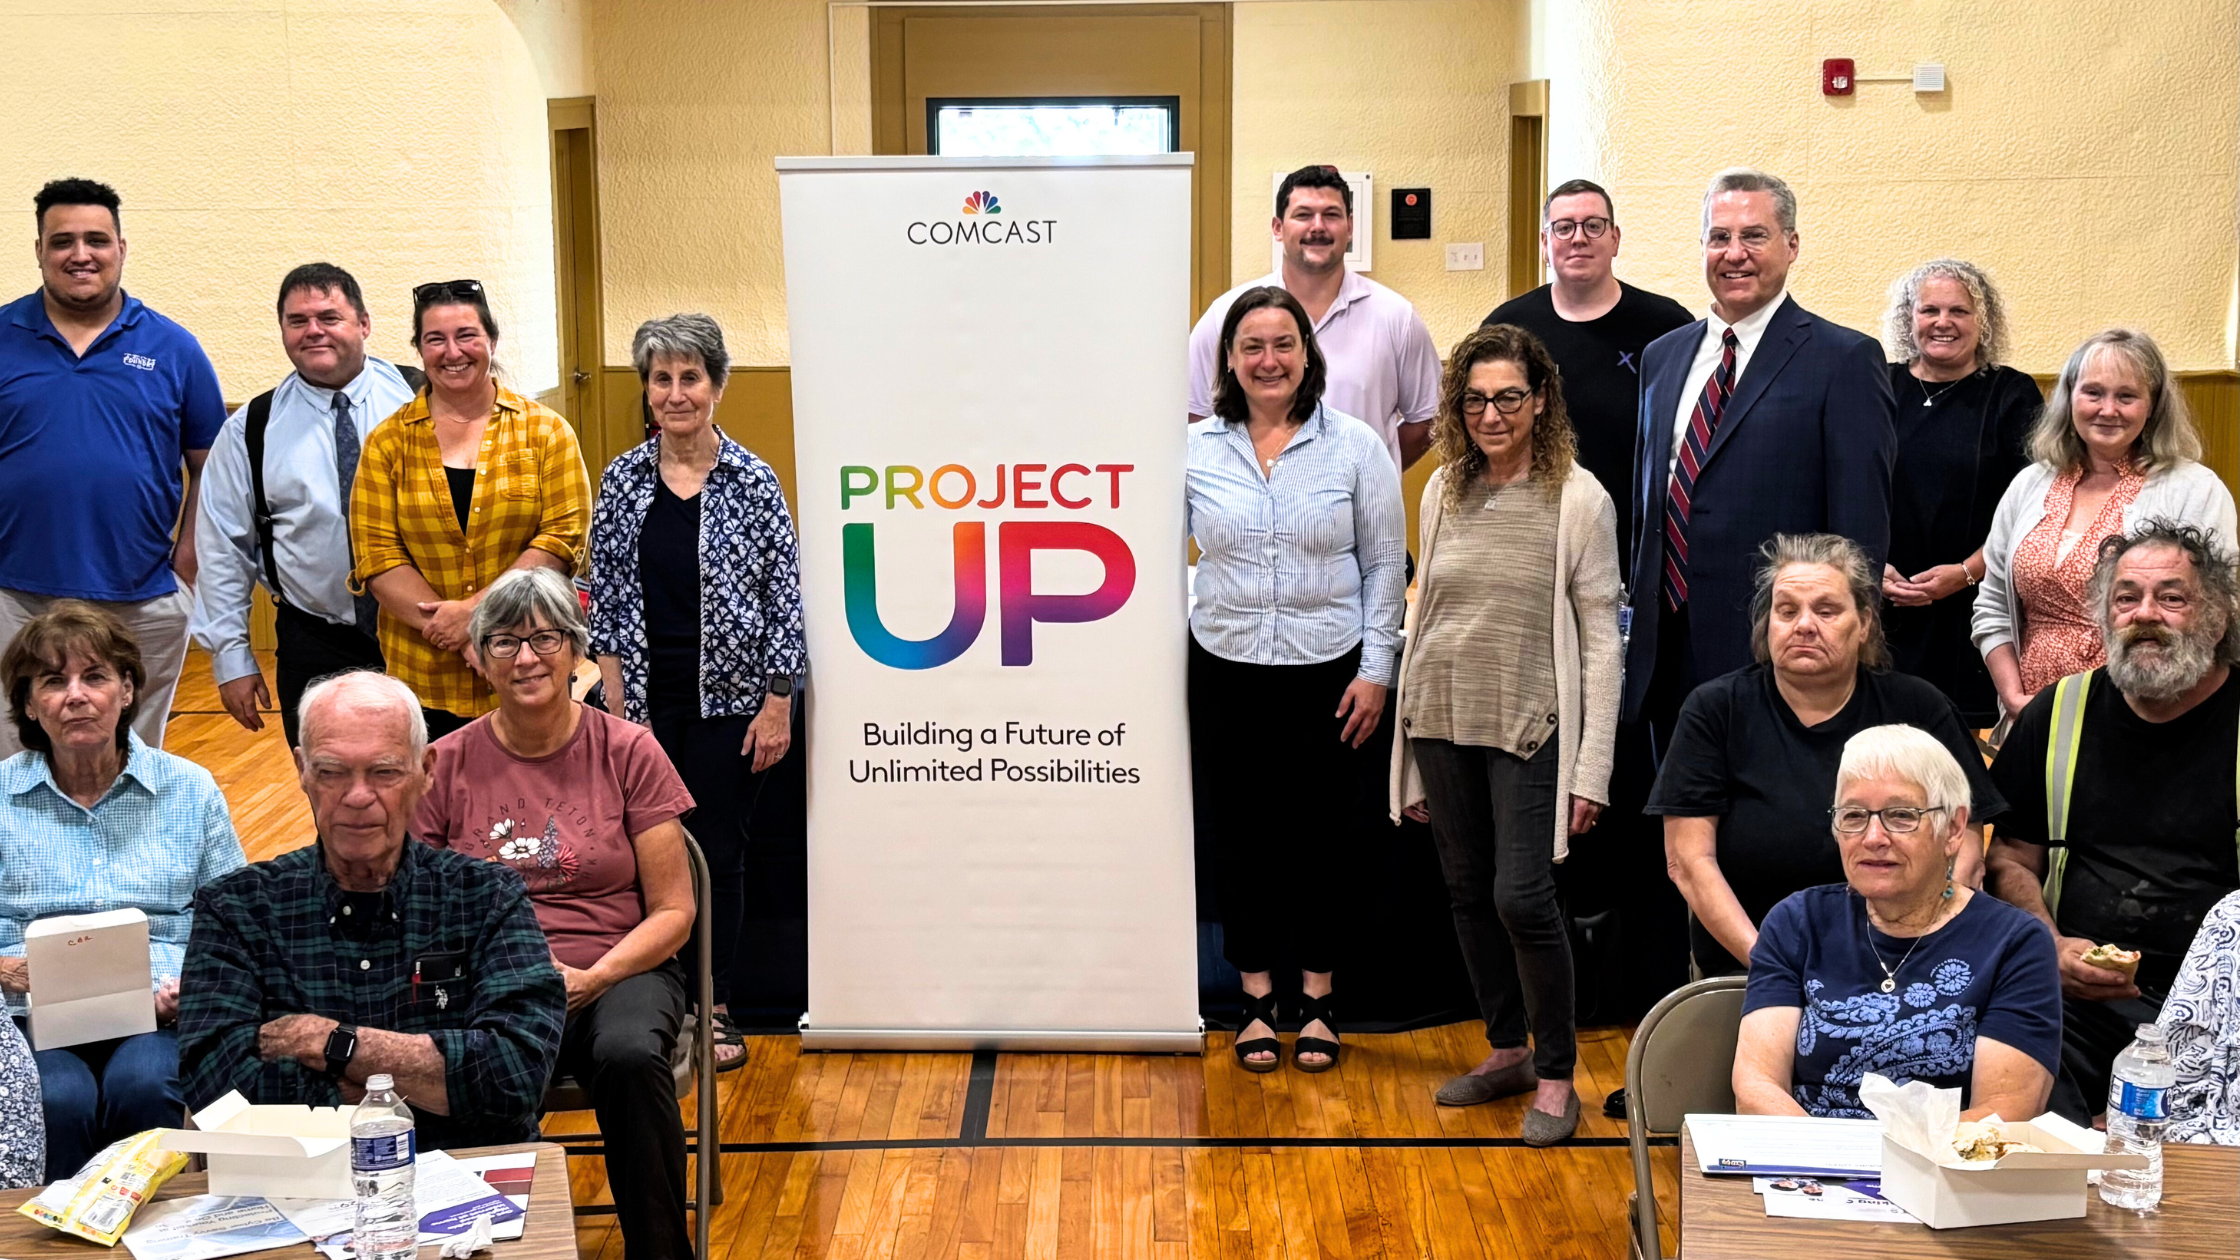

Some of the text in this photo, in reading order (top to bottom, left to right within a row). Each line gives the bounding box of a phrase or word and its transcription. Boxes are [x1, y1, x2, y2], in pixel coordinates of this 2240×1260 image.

[907, 220, 1058, 245] COMCAST
[840, 462, 1135, 511] PROJECT
[843, 520, 1137, 670] UP
[863, 721, 1126, 753] Building a Future of
[849, 757, 1141, 784] Unlimited Possibilities
[465, 797, 596, 851] GRAND TETON
